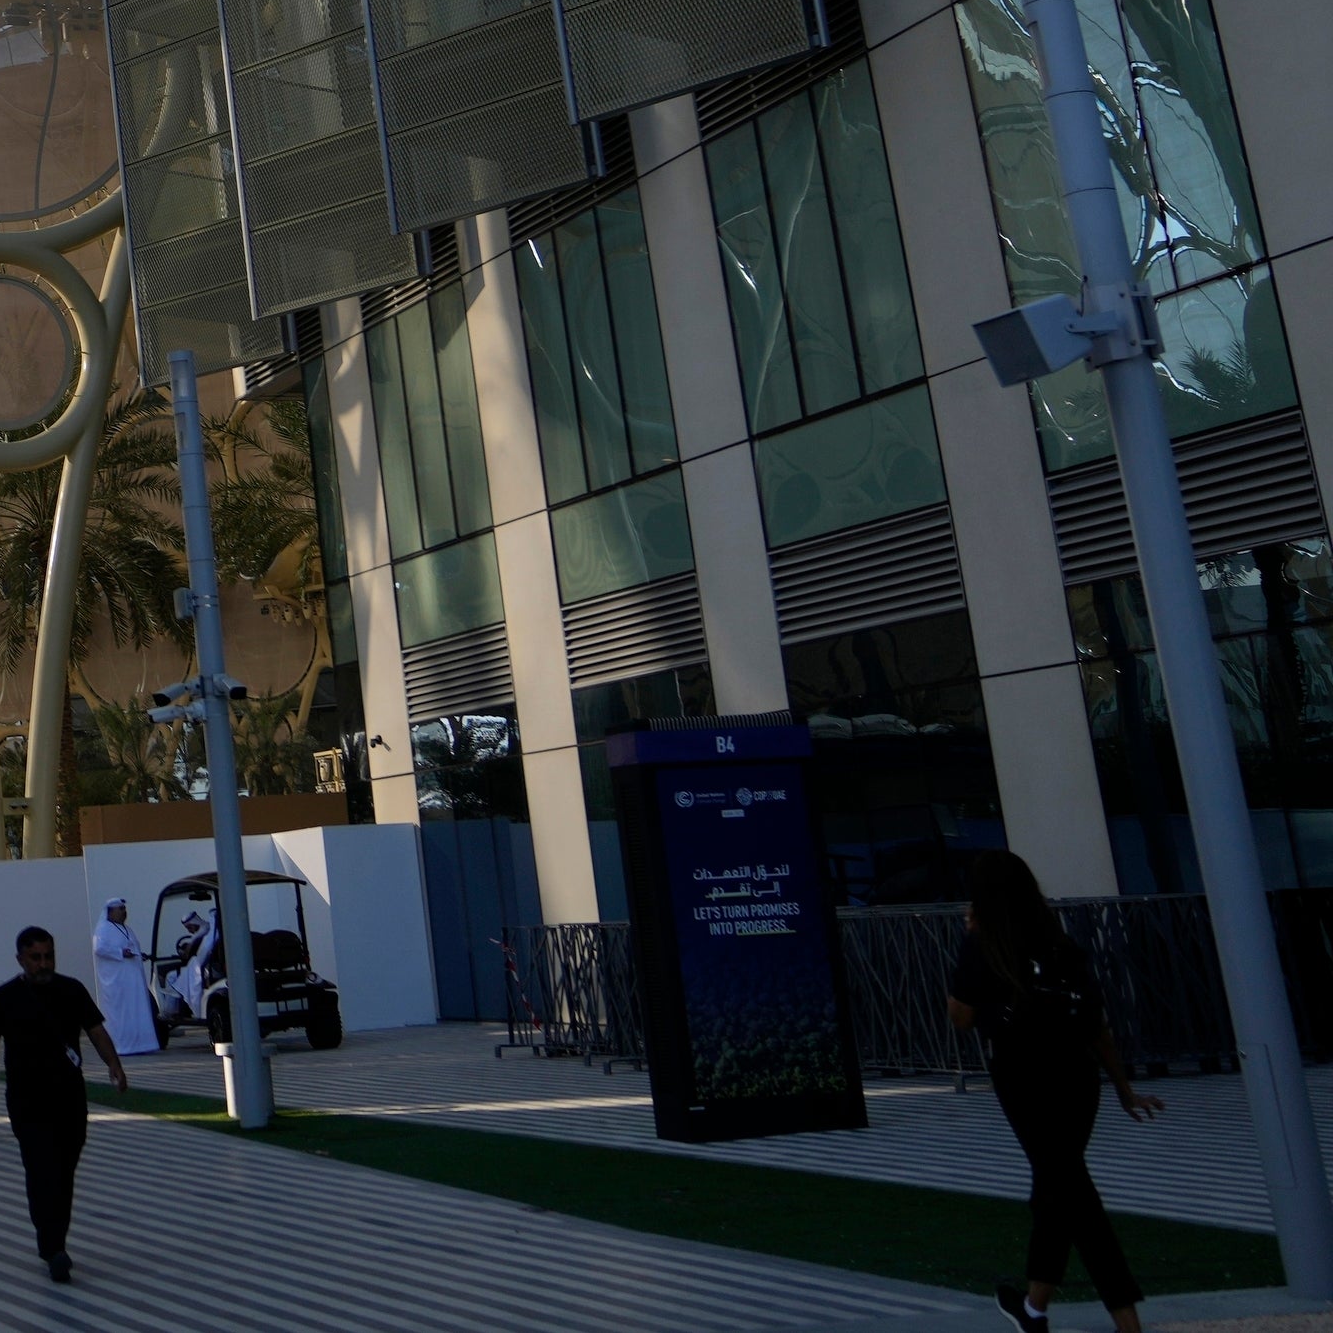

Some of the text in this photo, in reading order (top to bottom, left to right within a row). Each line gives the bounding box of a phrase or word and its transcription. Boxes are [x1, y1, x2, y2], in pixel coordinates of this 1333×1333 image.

[715, 735, 735, 754] B4
[693, 902, 800, 920] LET'S TURN PROMISES
[709, 921, 734, 936] INTO
